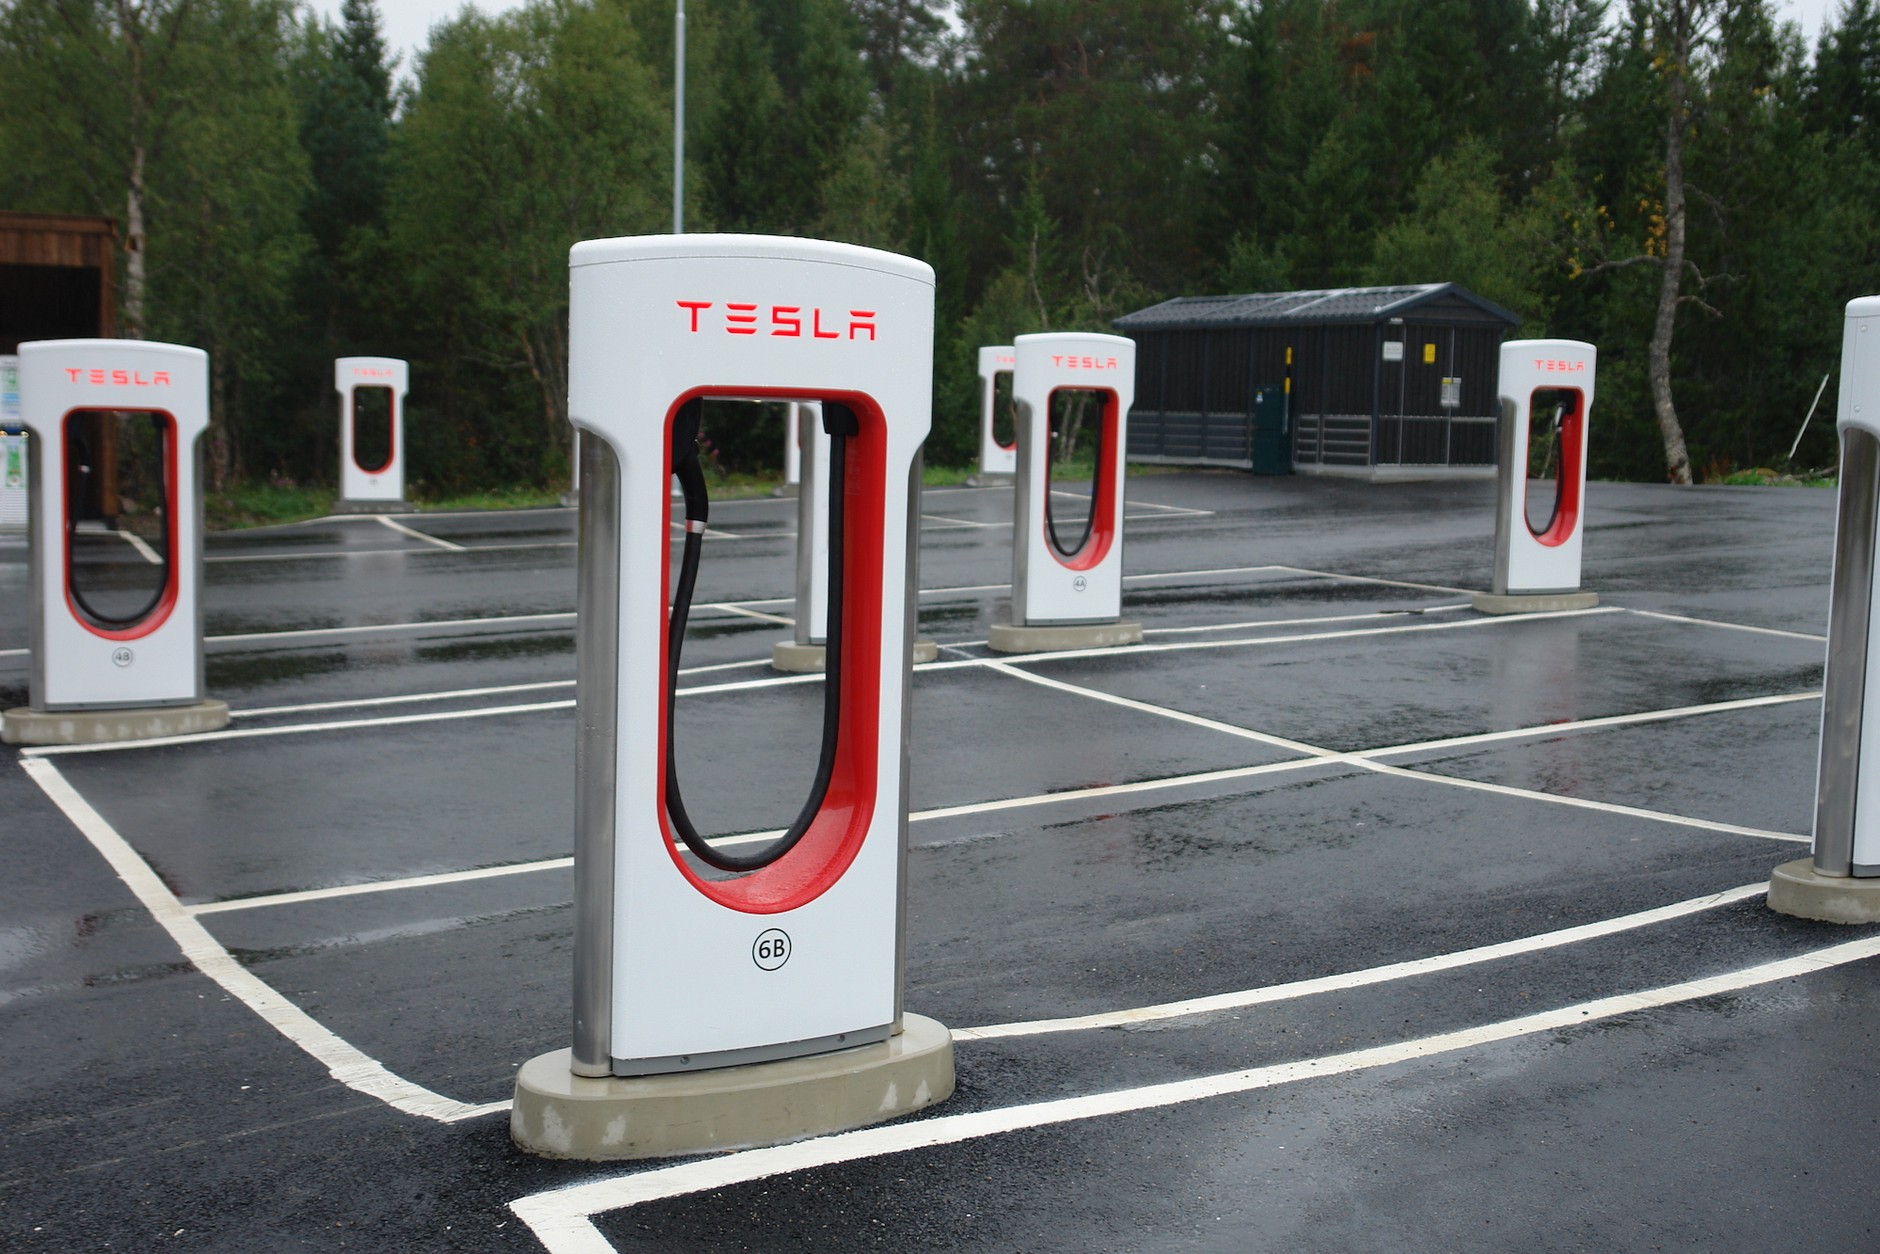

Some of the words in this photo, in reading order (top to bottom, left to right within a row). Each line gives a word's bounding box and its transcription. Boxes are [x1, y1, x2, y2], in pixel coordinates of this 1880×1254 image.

[676, 300, 876, 341] TESLA
[1052, 355, 1117, 369] TESLA
[1535, 359, 1585, 372] TESLA
[64, 368, 171, 386] TESLA
[758, 938, 786, 959] 6B
